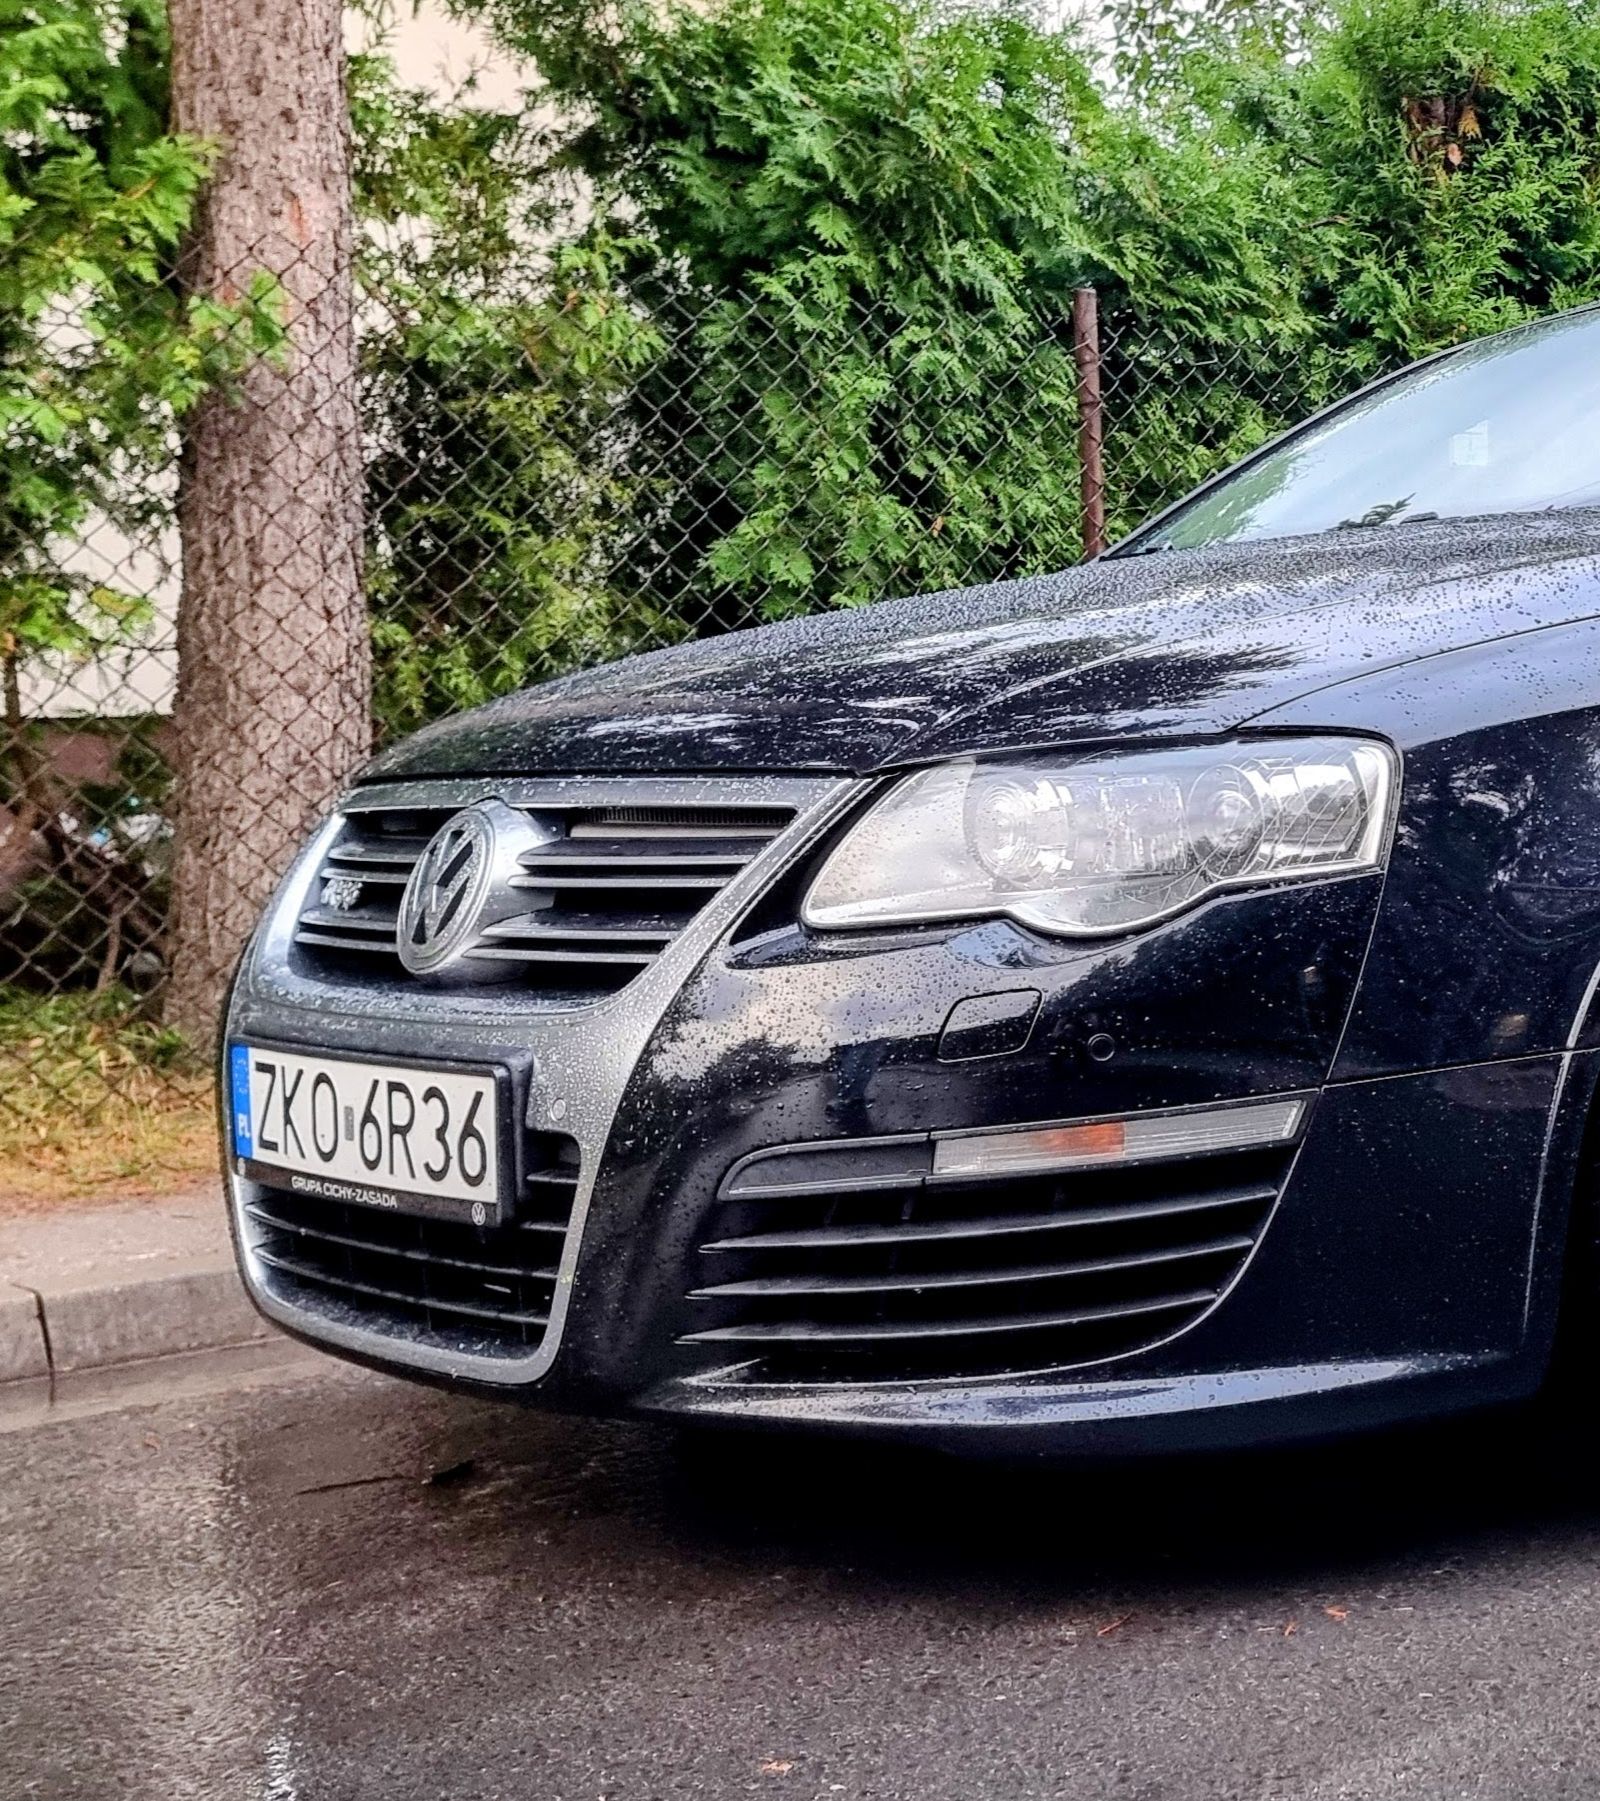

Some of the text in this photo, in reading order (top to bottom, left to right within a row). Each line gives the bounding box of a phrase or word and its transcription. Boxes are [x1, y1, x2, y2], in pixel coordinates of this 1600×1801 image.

[238, 1113, 250, 1138] PL
[254, 1061, 487, 1187] ZKO 6R36
[291, 1176, 398, 1208] GRUPA CICHY-ZASADA
